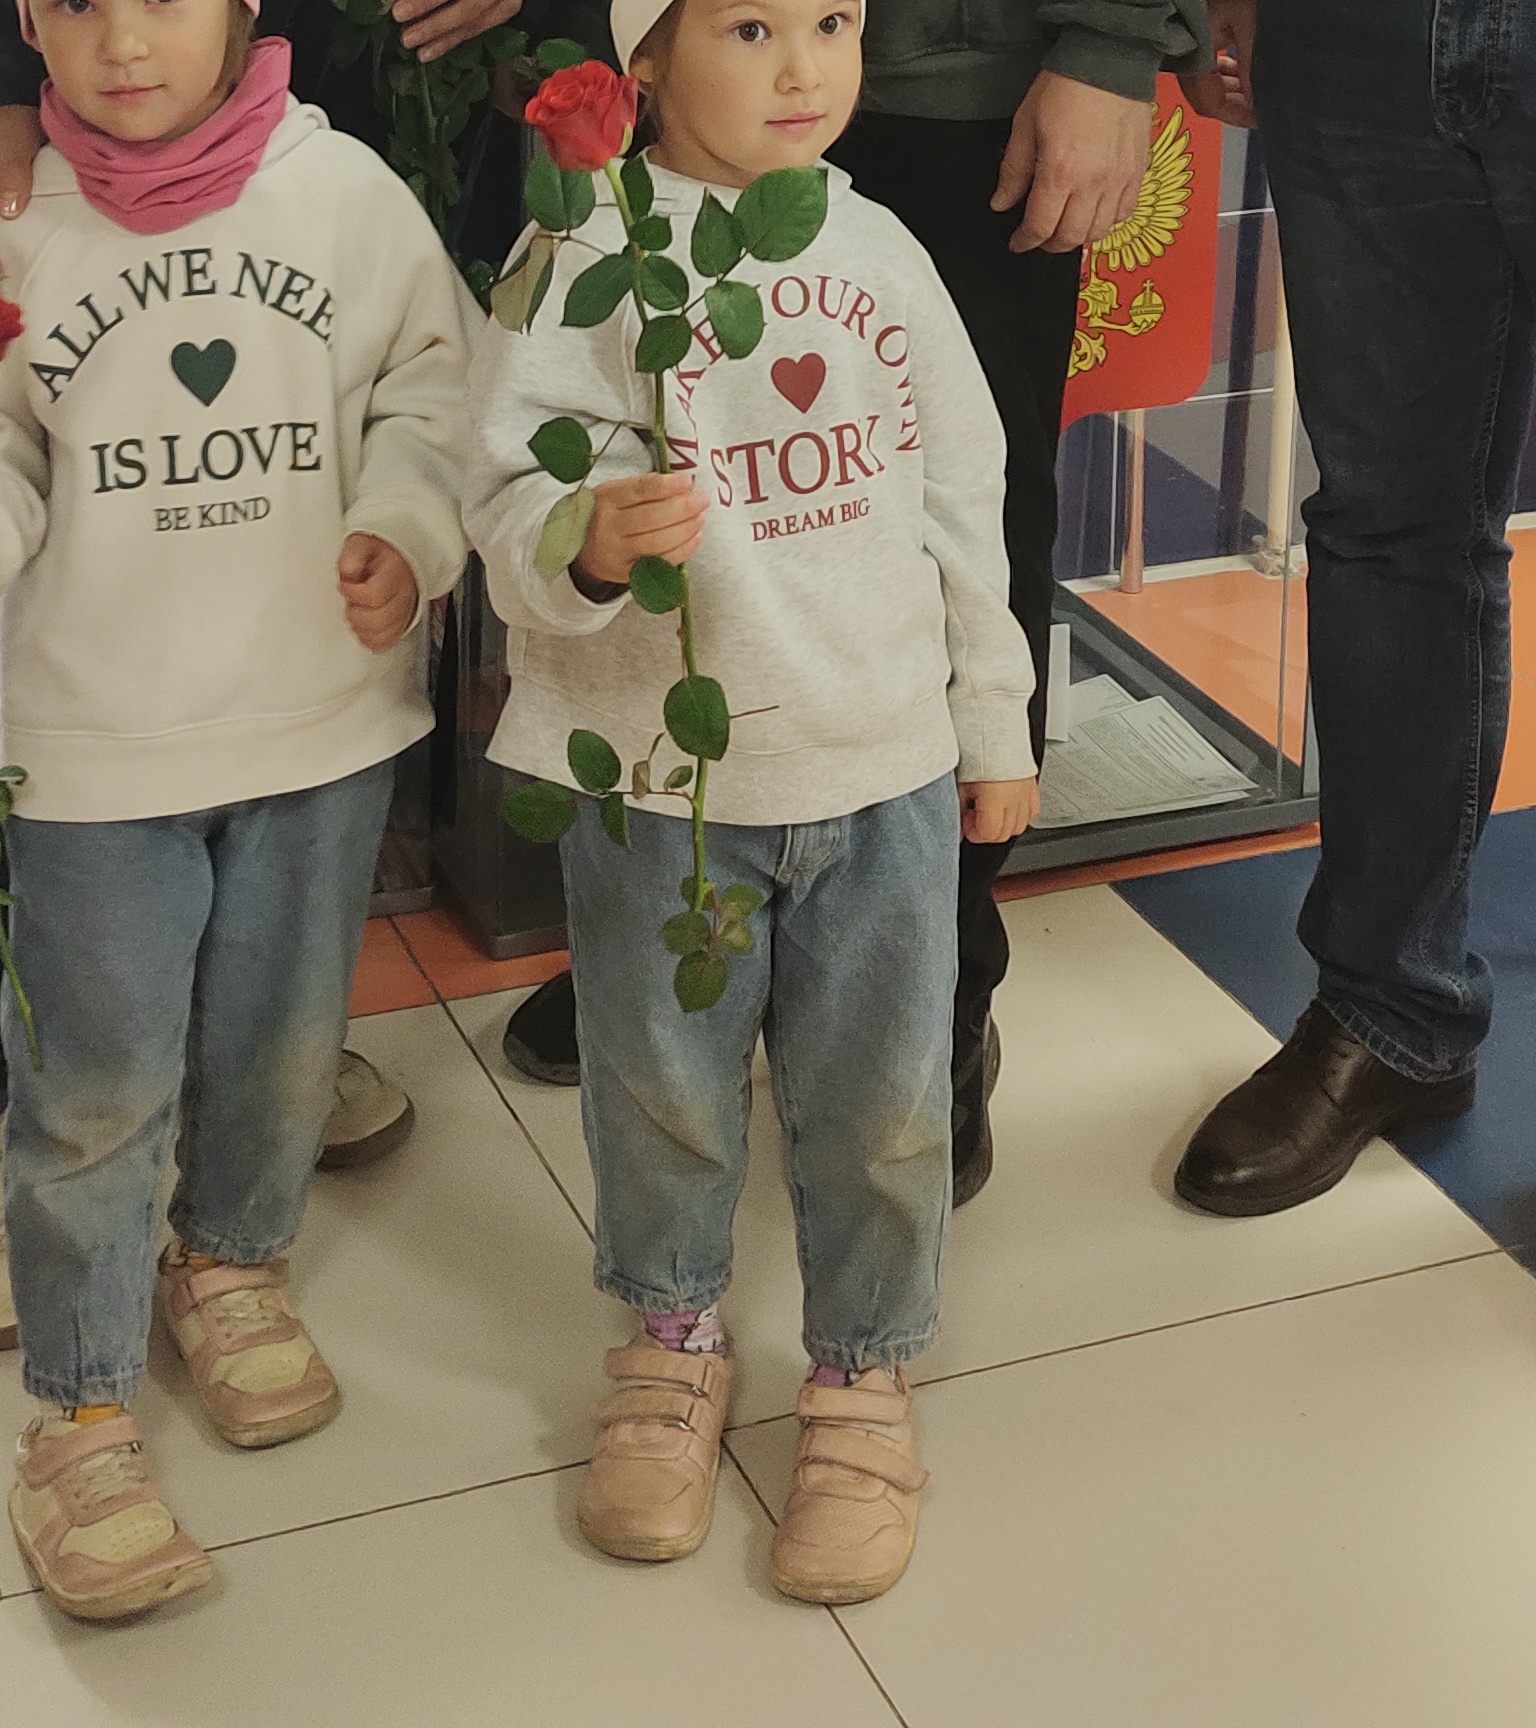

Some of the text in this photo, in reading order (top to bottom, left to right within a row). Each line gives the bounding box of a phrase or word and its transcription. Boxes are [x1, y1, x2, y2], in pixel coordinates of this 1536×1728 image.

[29, 292, 125, 403] ALL
[119, 247, 218, 311] WE
[756, 273, 875, 340] OUR
[89, 420, 322, 494] IS LOVE
[153, 495, 271, 532] BE KIND
[750, 497, 871, 542] DREAM BIG
